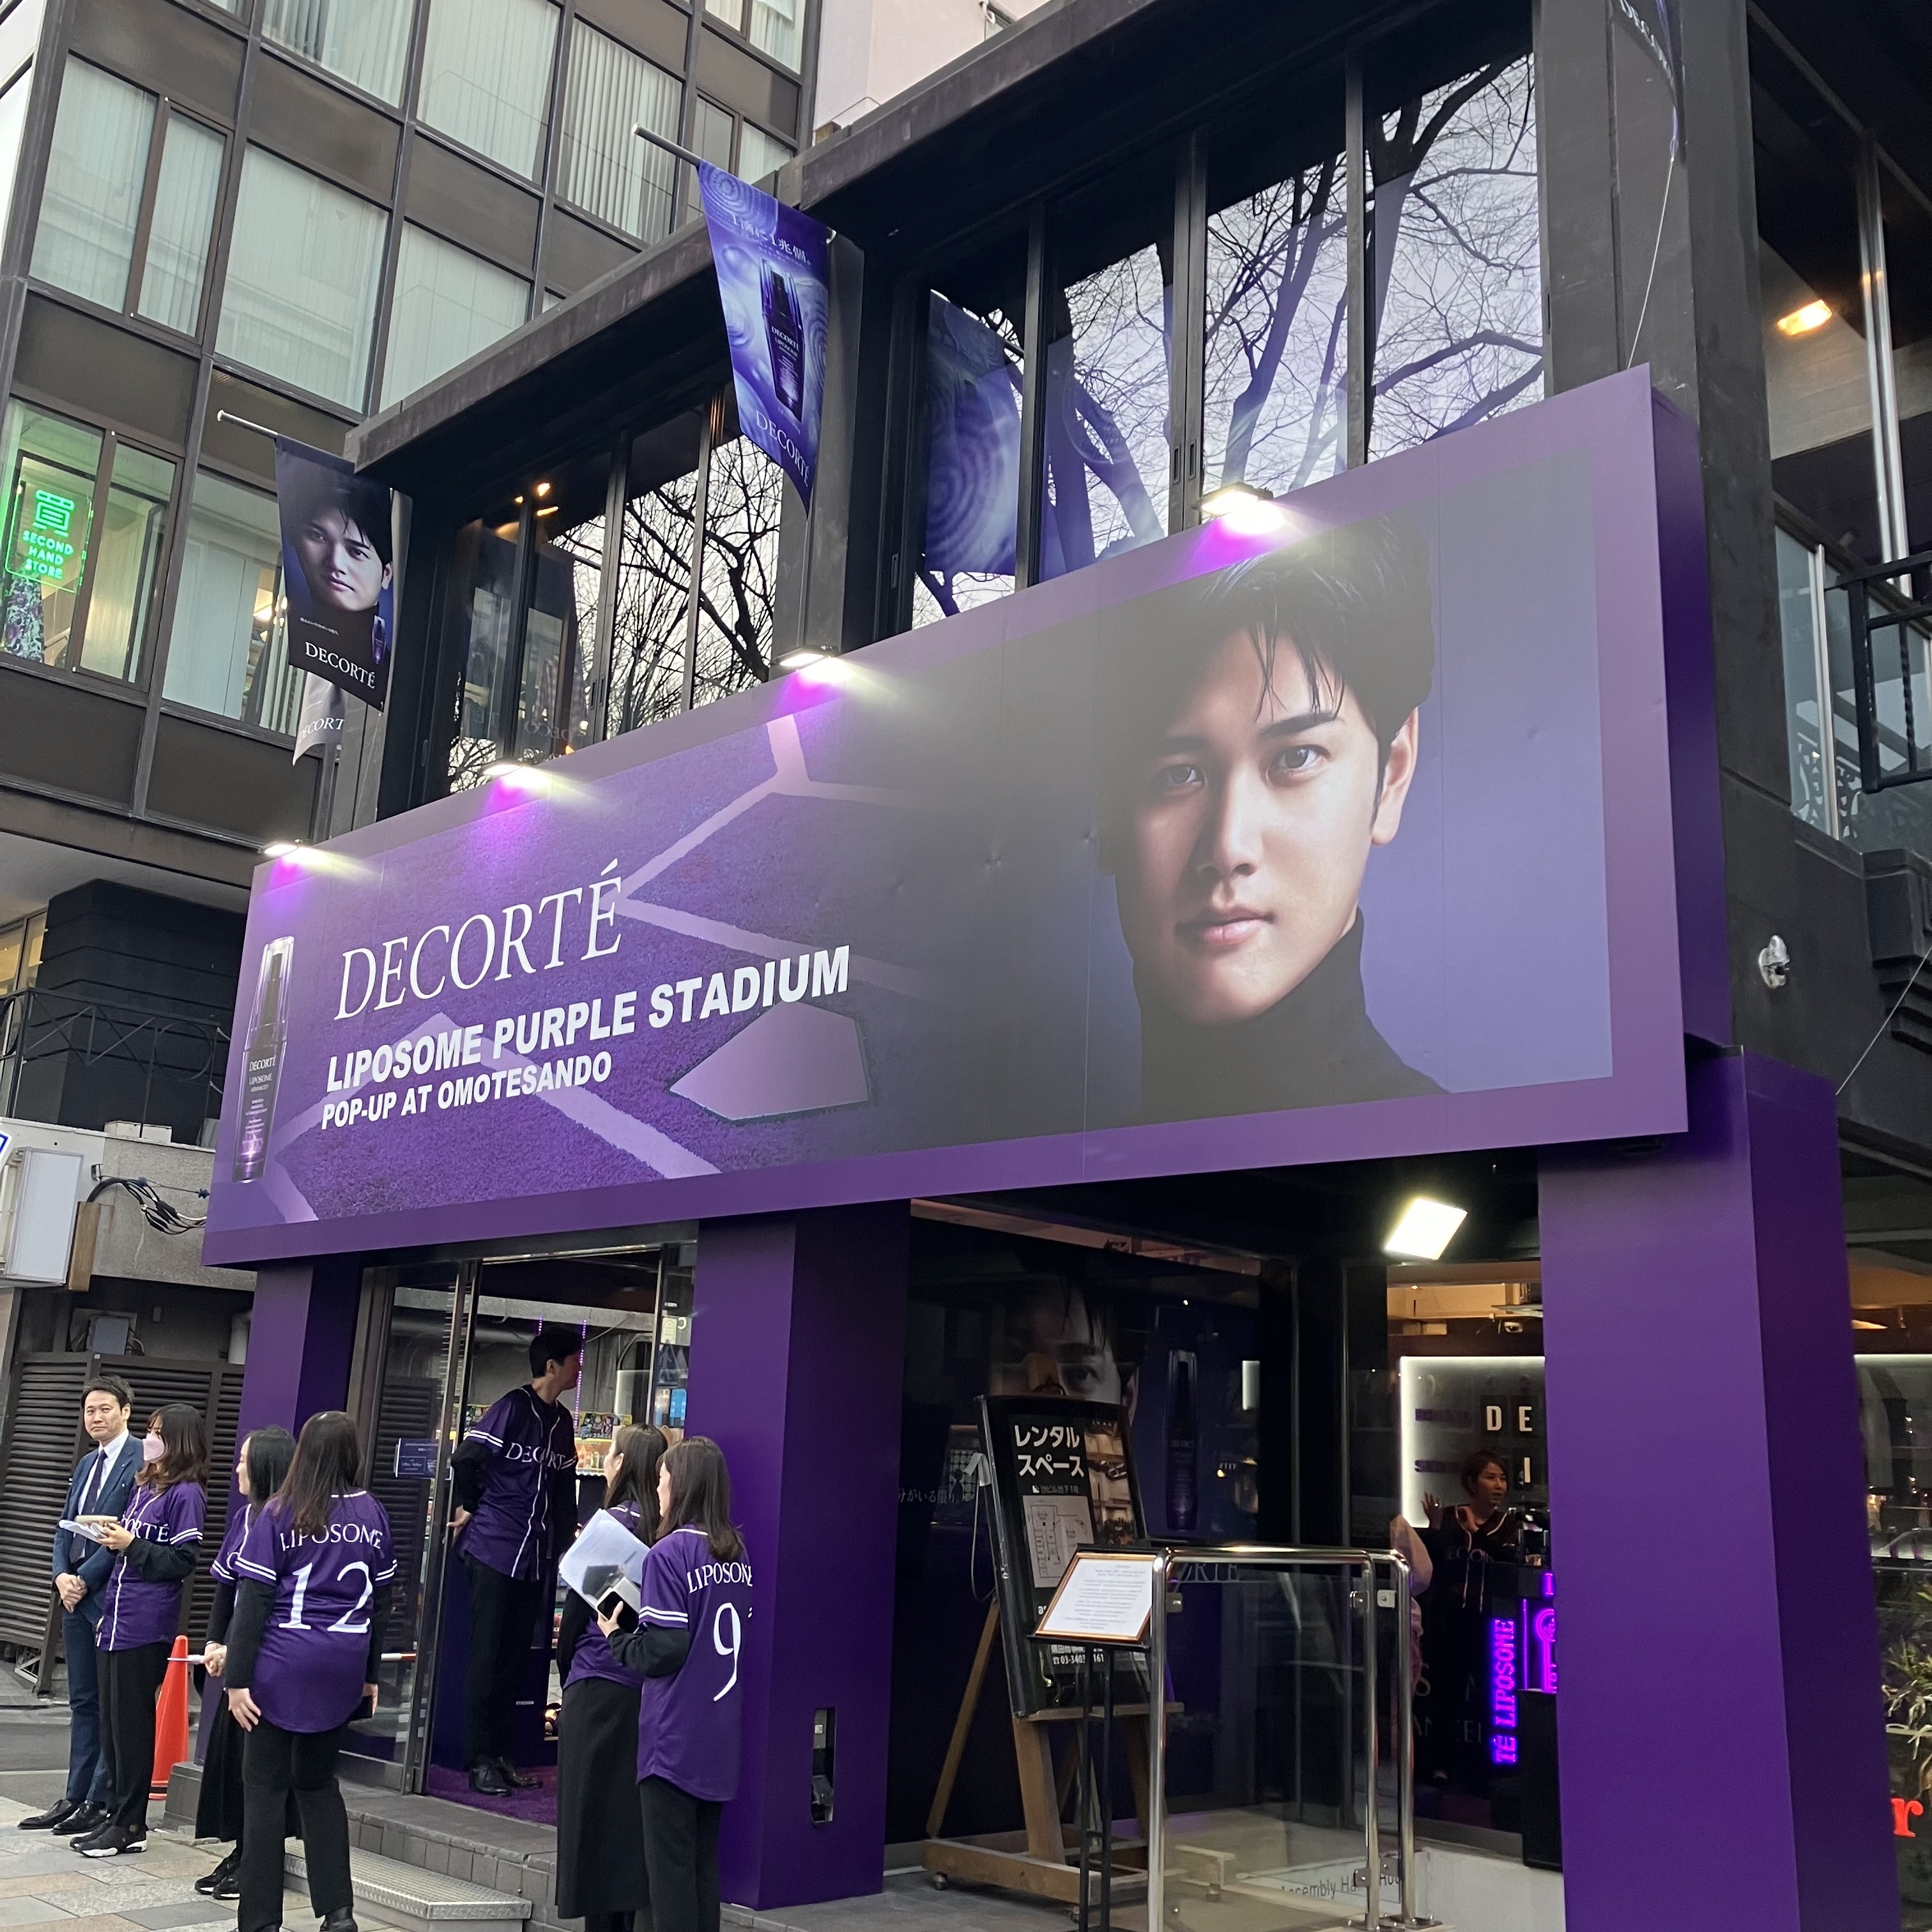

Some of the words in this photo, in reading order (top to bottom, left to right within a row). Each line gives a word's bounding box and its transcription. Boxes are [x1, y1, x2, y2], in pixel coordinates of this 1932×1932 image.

[22, 530, 74, 556] SECOND
[25, 558, 63, 579] STORE
[28, 546, 64, 565] HAND
[305, 641, 376, 689] DECORTÉ
[334, 858, 622, 1020] DECORTÉ
[326, 1024, 484, 1092] LIPOSOME
[493, 991, 637, 1059] PURPLE
[648, 945, 850, 1029] STADIUM
[321, 1091, 397, 1130] POP-UP
[401, 1085, 433, 1116] AT
[438, 1051, 612, 1110] OMOTESANDO
[1015, 1425, 1080, 1448] レンタル
[1018, 1453, 1084, 1477] スペース
[279, 1561, 372, 1633] 12
[713, 1602, 741, 1702] 9
[1494, 1620, 1515, 1727] LIPOSOME
